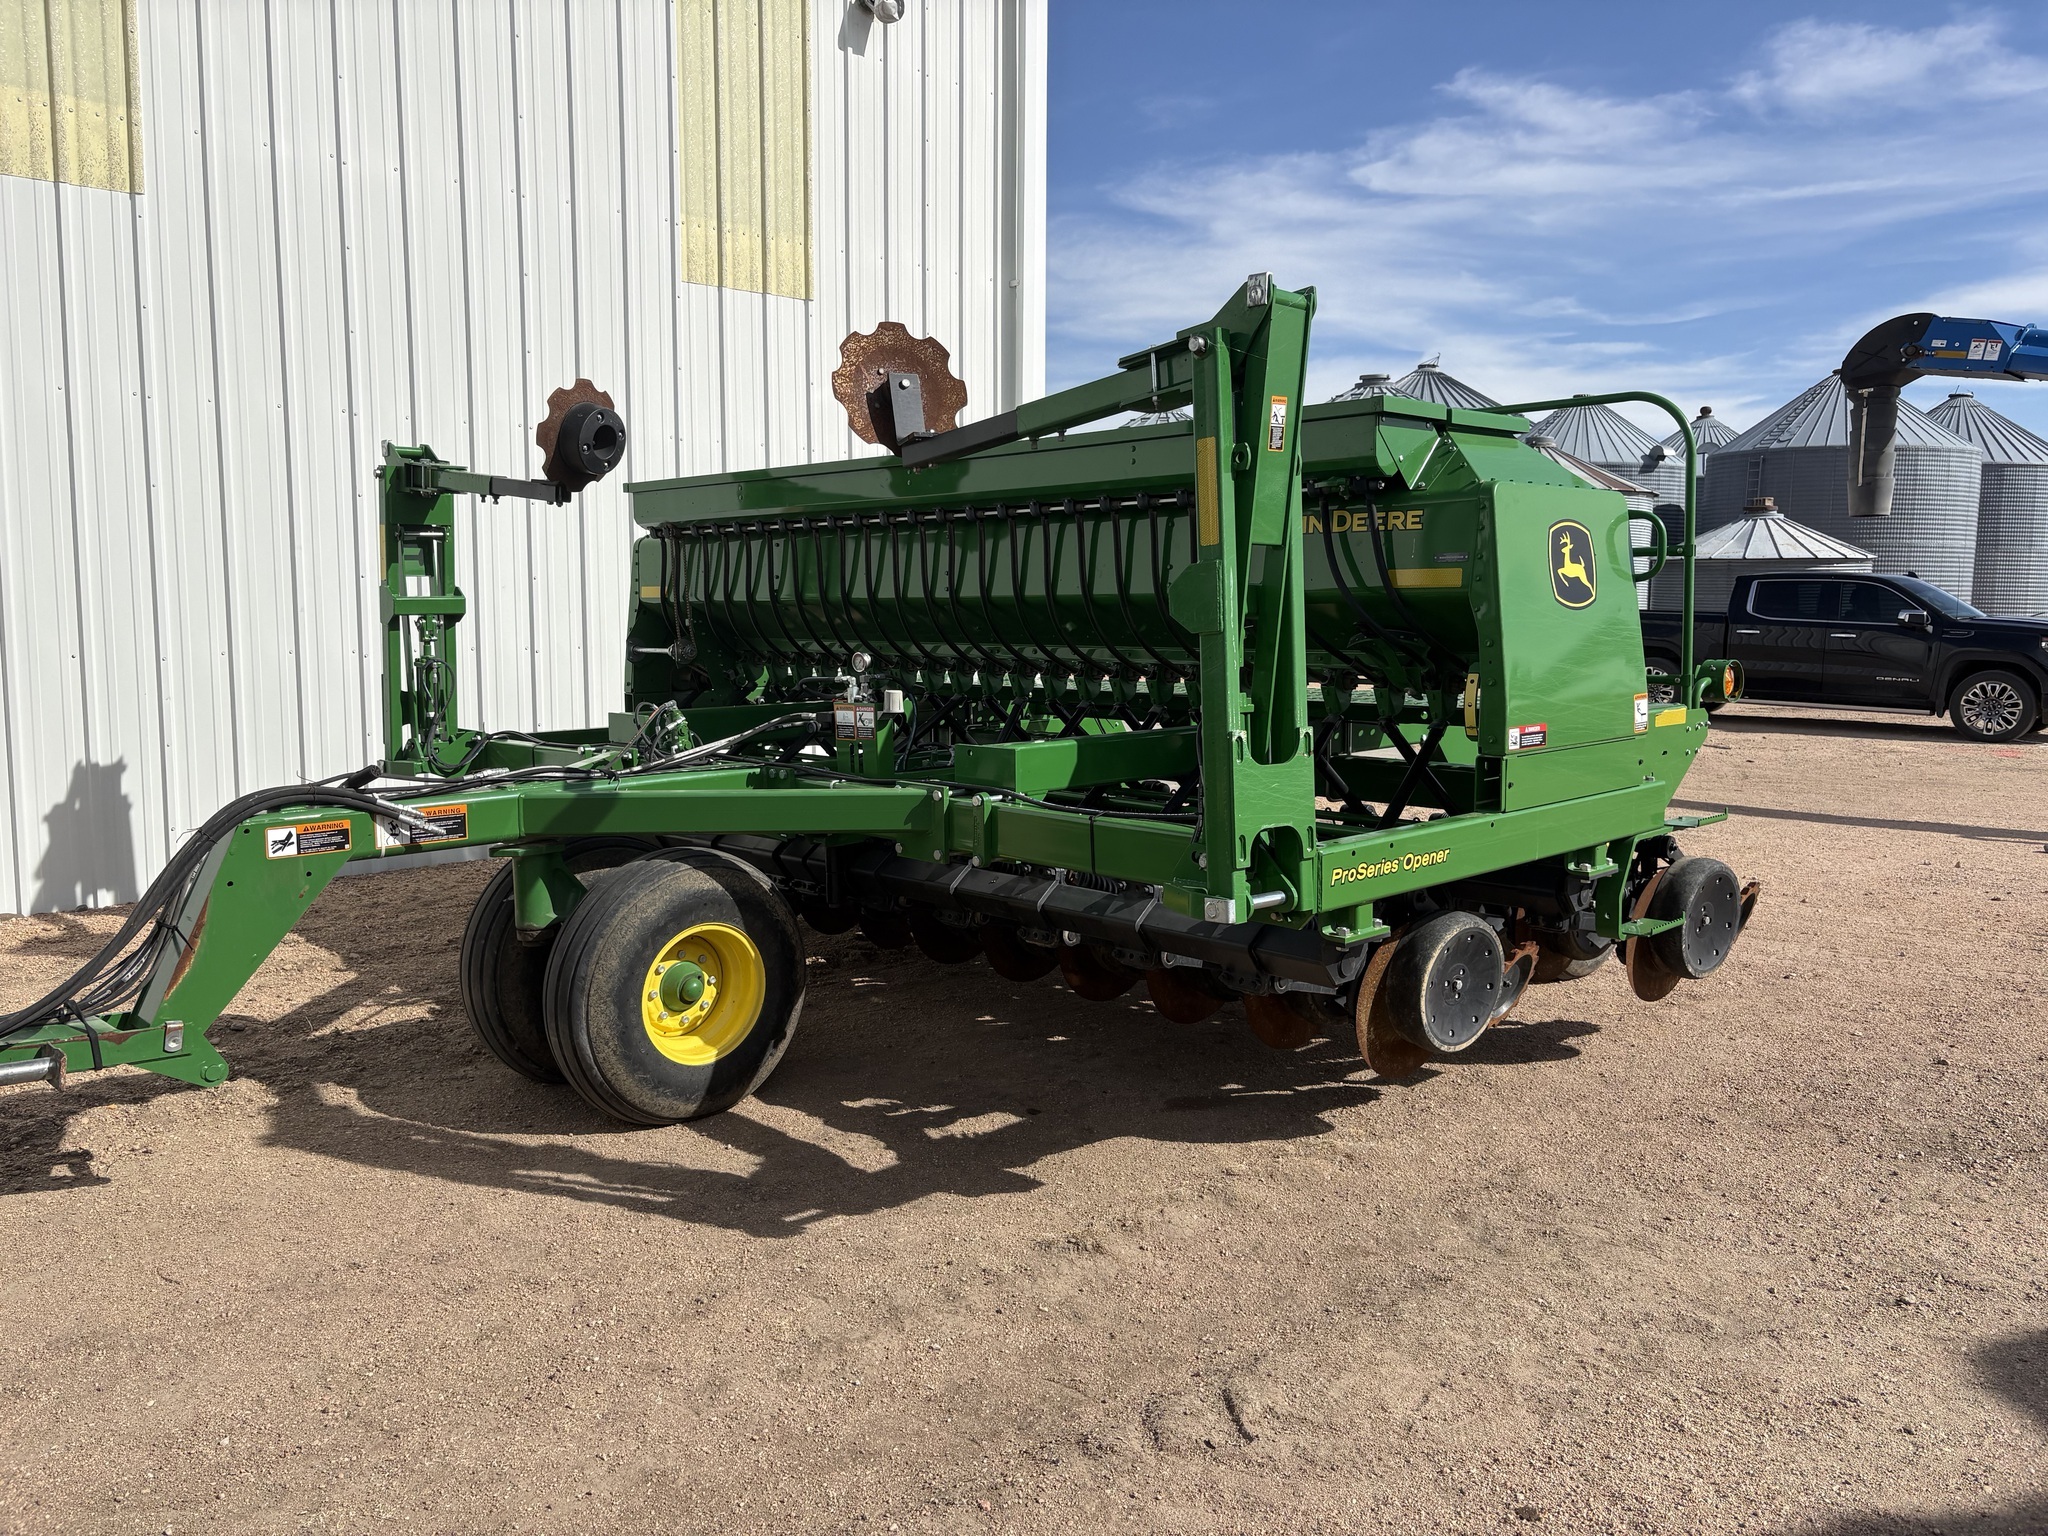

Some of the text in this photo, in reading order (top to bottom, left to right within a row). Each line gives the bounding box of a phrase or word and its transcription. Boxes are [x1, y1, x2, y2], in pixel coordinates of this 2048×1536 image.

[425, 807, 461, 816] WARNING
[309, 822, 344, 831] WARNING
[1403, 848, 1451, 873] Opener
